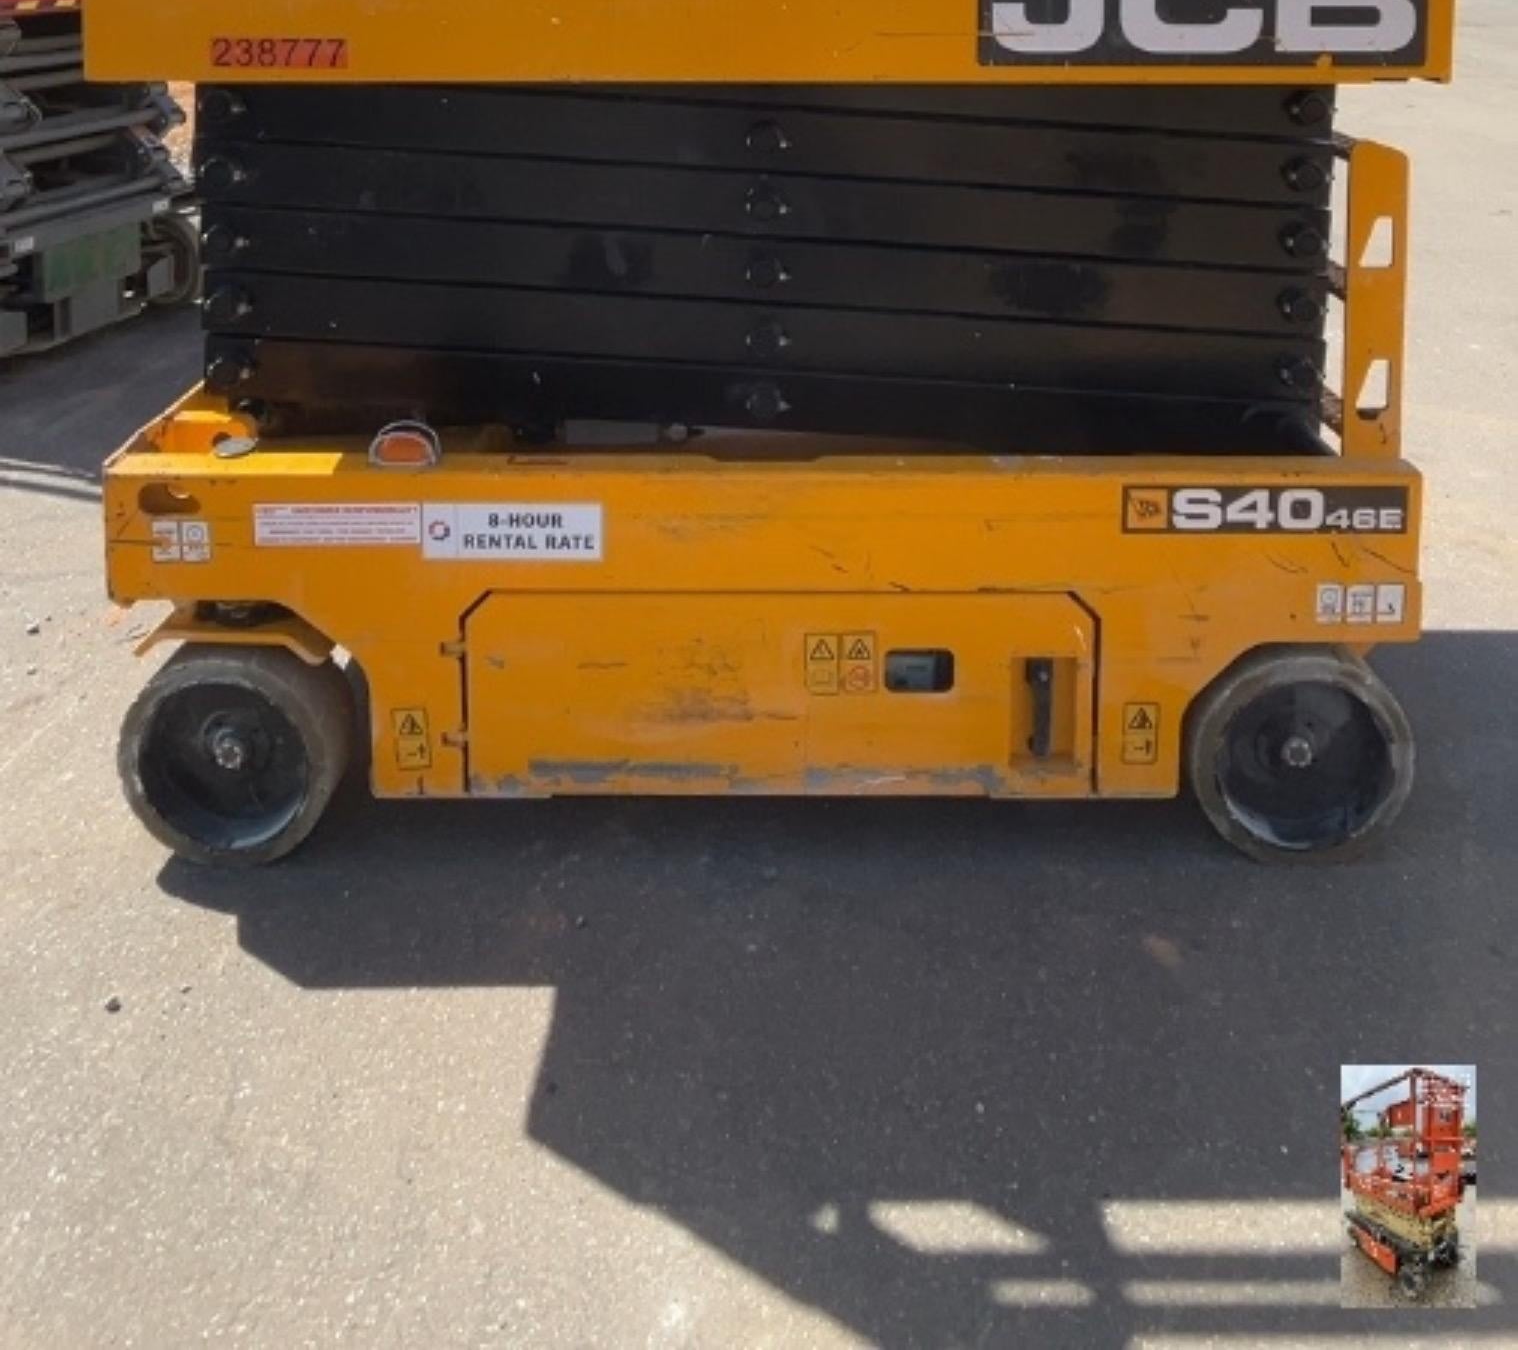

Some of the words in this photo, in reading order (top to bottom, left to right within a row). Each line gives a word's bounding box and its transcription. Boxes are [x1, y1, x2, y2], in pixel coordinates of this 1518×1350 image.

[212, 38, 345, 67] 238777
[488, 512, 563, 528] 8-HOUR
[463, 534, 538, 550] RENTAL
[545, 534, 595, 550] RATE
